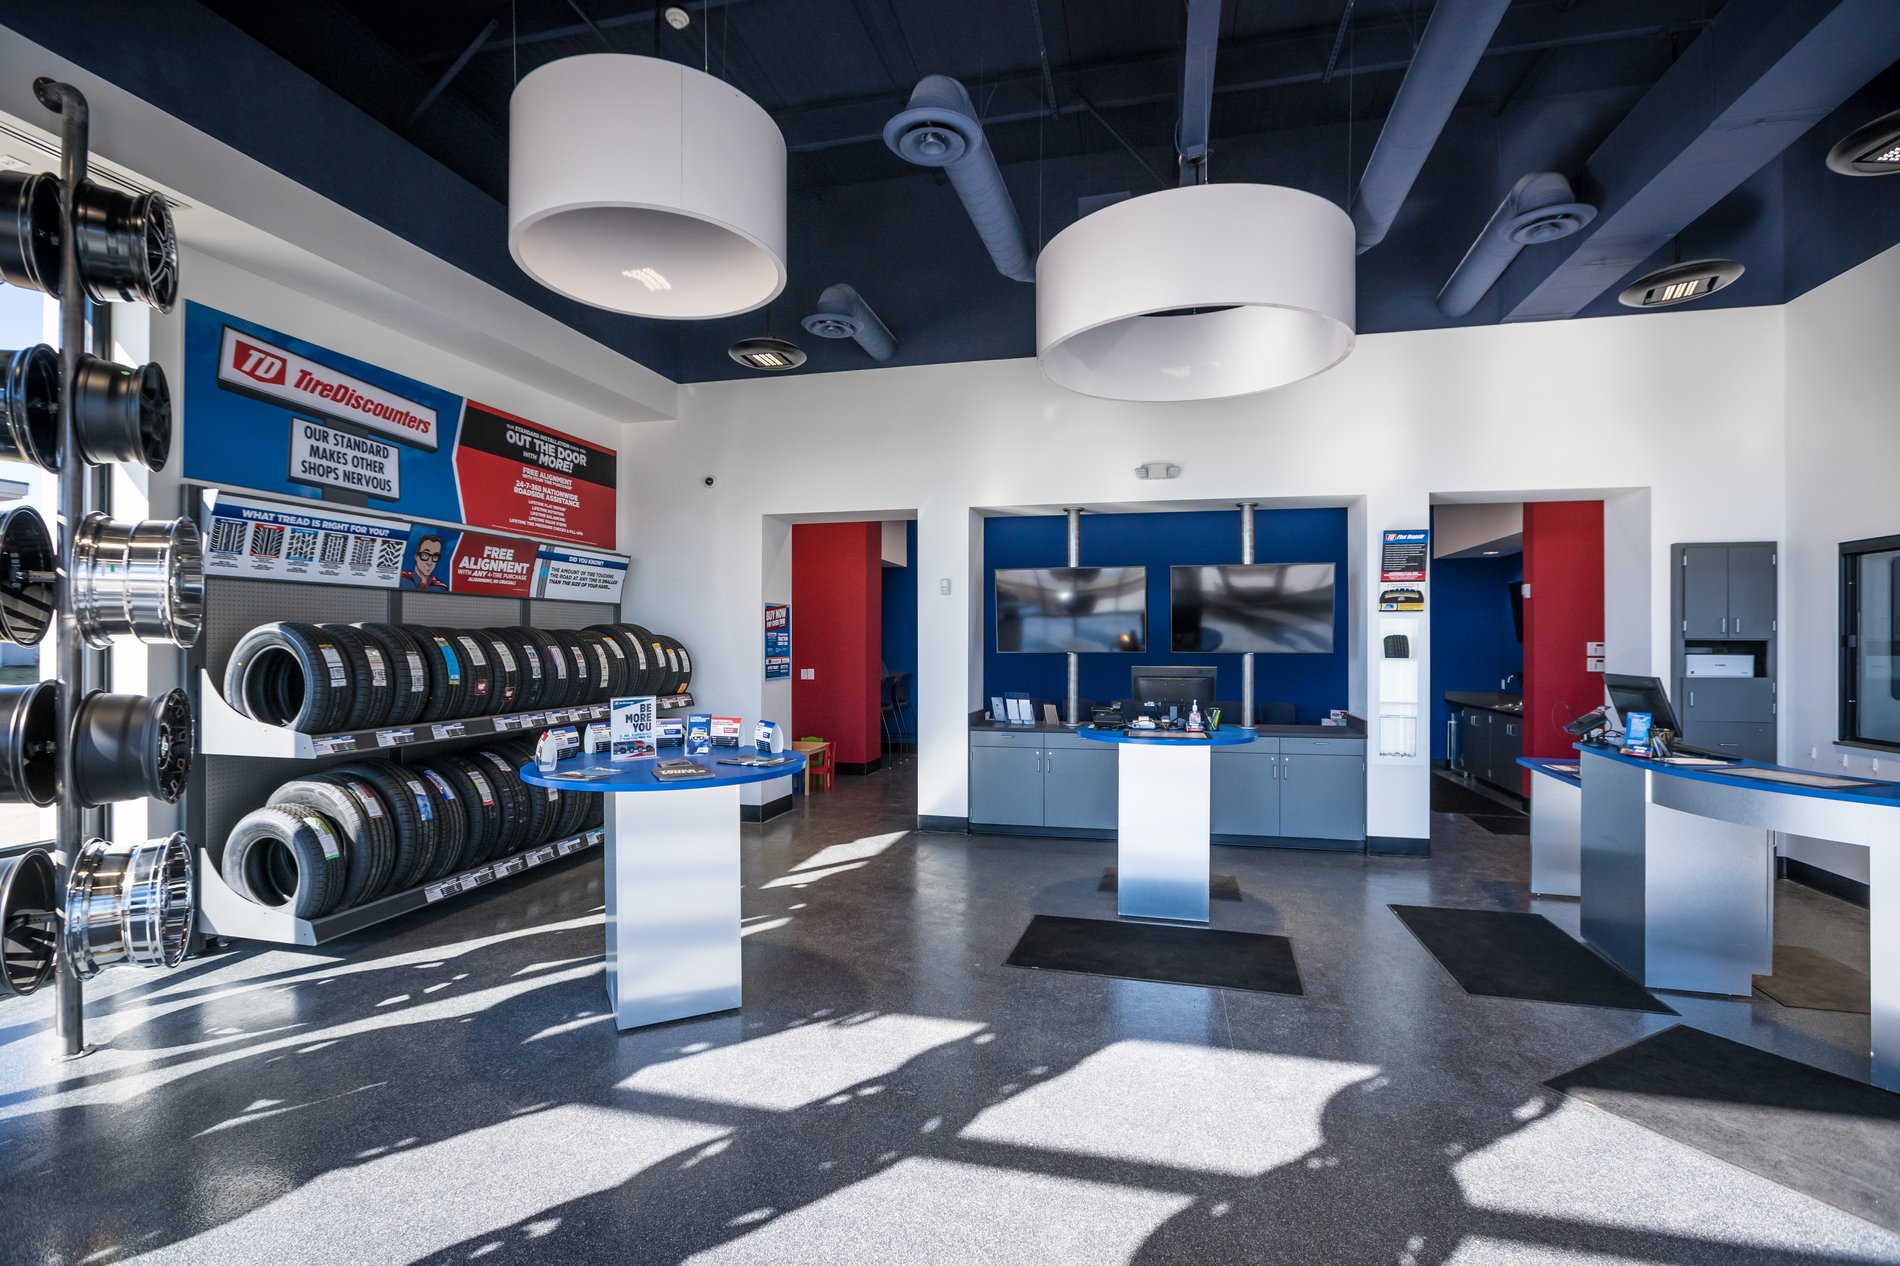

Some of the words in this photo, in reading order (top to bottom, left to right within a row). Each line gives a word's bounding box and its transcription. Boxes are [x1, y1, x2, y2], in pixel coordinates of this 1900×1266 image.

[241, 350, 283, 379] TD
[293, 368, 431, 434] TireDiscounters
[304, 425, 329, 444] OUR
[334, 433, 390, 459] STANDARD
[506, 430, 532, 448] OUT
[534, 438, 555, 457] THE
[557, 446, 587, 466] DOOR
[515, 426, 540, 439] STANDARD
[540, 434, 570, 448] INSTALLATION
[309, 444, 348, 466] MAKES
[351, 455, 385, 475] OTHER
[523, 451, 538, 460] WITH
[538, 453, 574, 473] MORE!
[301, 460, 339, 481] SHOPS
[342, 469, 392, 492] NERVOUS
[522, 466, 539, 478] FREE
[540, 471, 572, 486] ALIGNMENT
[514, 486, 545, 500] ROADSIDE
[546, 494, 580, 508] ASSISTANCE
[515, 480, 542, 492] 24-7-365
[543, 487, 578, 501] NATIONWIDE
[242, 508, 276, 522] WHAT
[277, 514, 310, 527] TREAD
[311, 519, 321, 528] IS
[322, 522, 350, 532] RIGHT
[350, 525, 367, 534] FOR
[368, 527, 390, 537] YOU?
[483, 546, 514, 560] FREE
[459, 556, 529, 574] ALIGNMENT
[766, 610, 775, 621] BUY
[776, 608, 786, 619] NOW
[625, 713, 652, 723] MORE
[640, 703, 652, 712] BE
[633, 723, 652, 732] YOU
